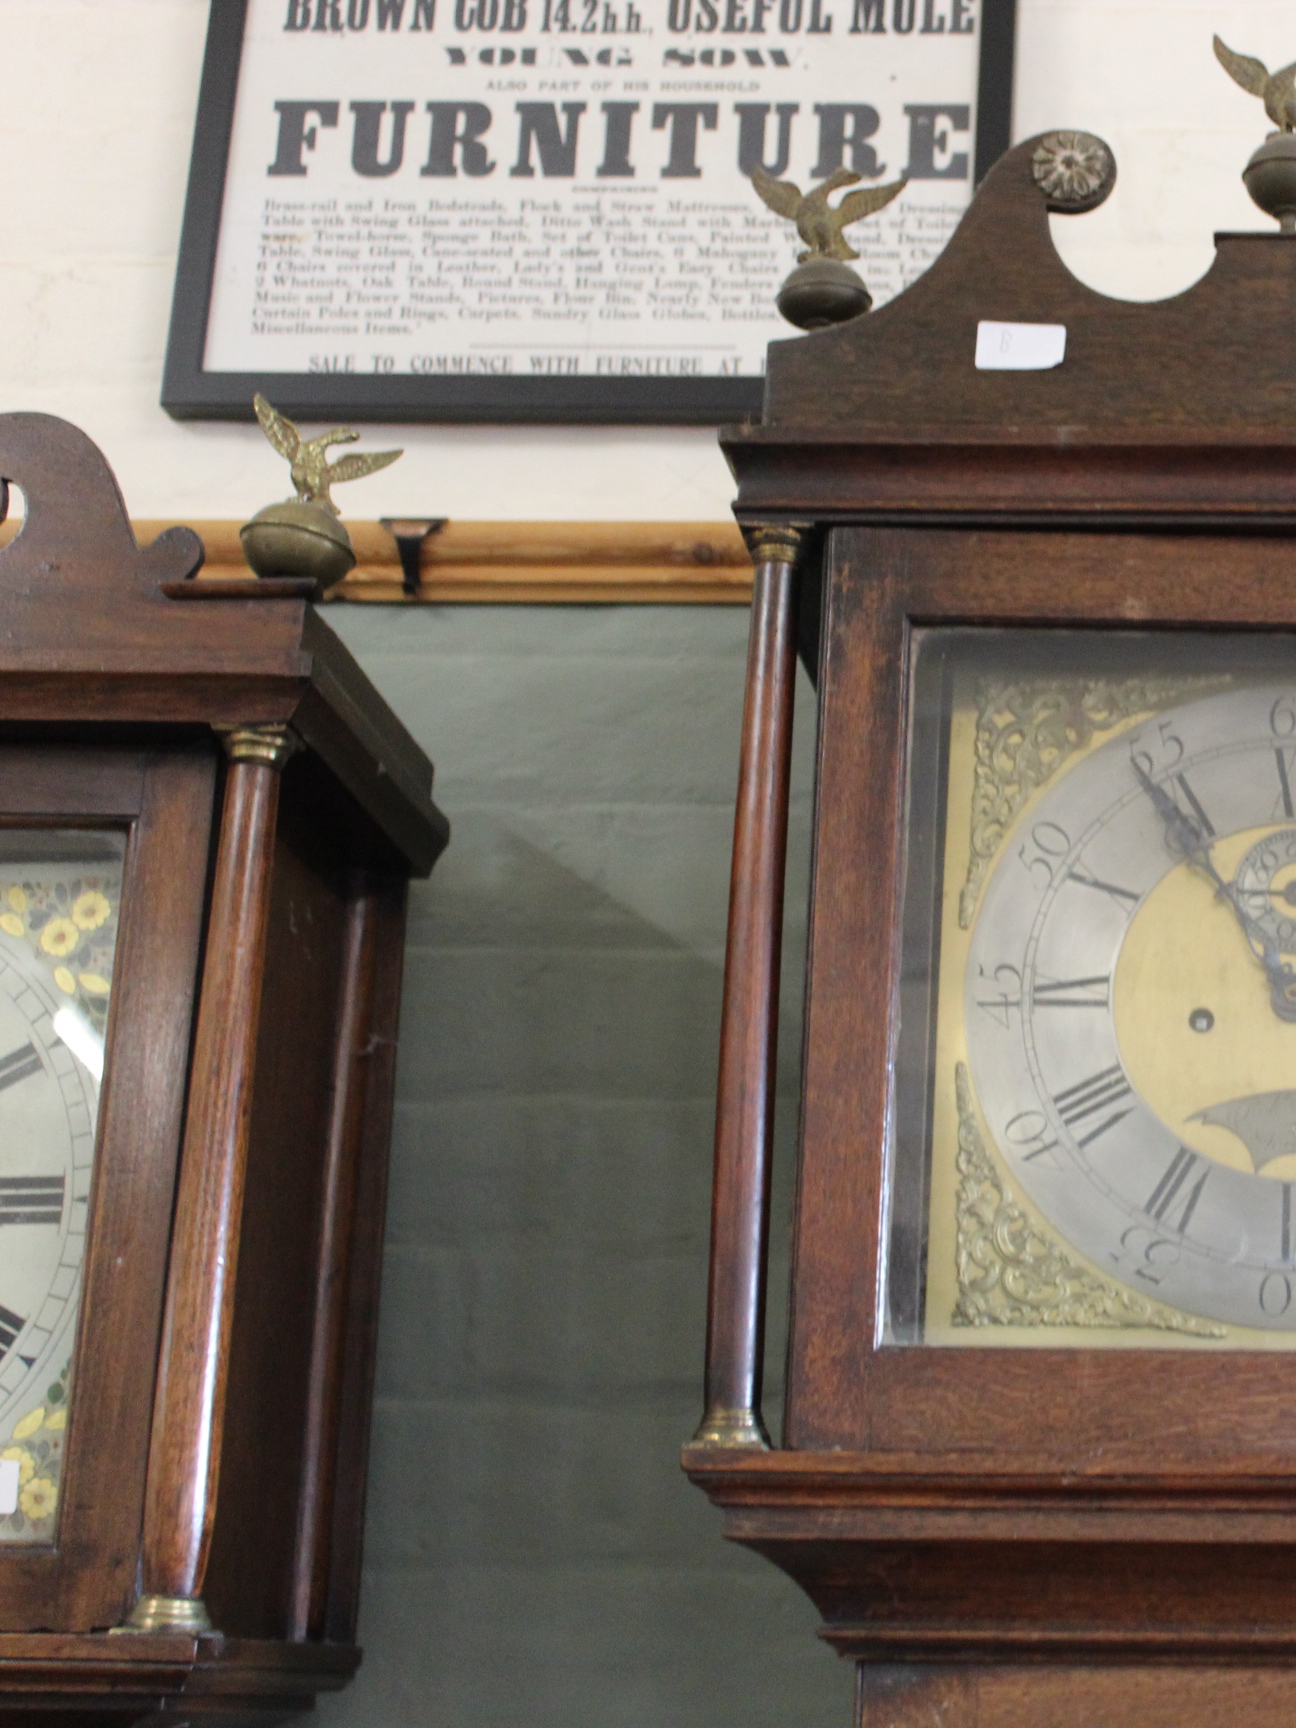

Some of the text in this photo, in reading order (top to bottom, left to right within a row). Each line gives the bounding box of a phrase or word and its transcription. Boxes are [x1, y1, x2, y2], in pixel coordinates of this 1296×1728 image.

[282, 0, 436, 34] BROWN
[453, 0, 528, 34] COB
[666, 0, 833, 35] USEFUL
[848, 0, 975, 36] MULE
[443, 46, 635, 67] YOUNG
[266, 100, 971, 181] FURNITURE
[308, 354, 356, 374] SALE
[371, 354, 395, 374] TO
[410, 355, 513, 374] COMMENCE
[530, 355, 580, 376] WITH
[597, 355, 703, 377] FURNITURE
[721, 356, 743, 377] AT
[1018, 821, 1072, 893] 50
[976, 962, 1022, 1031] 45
